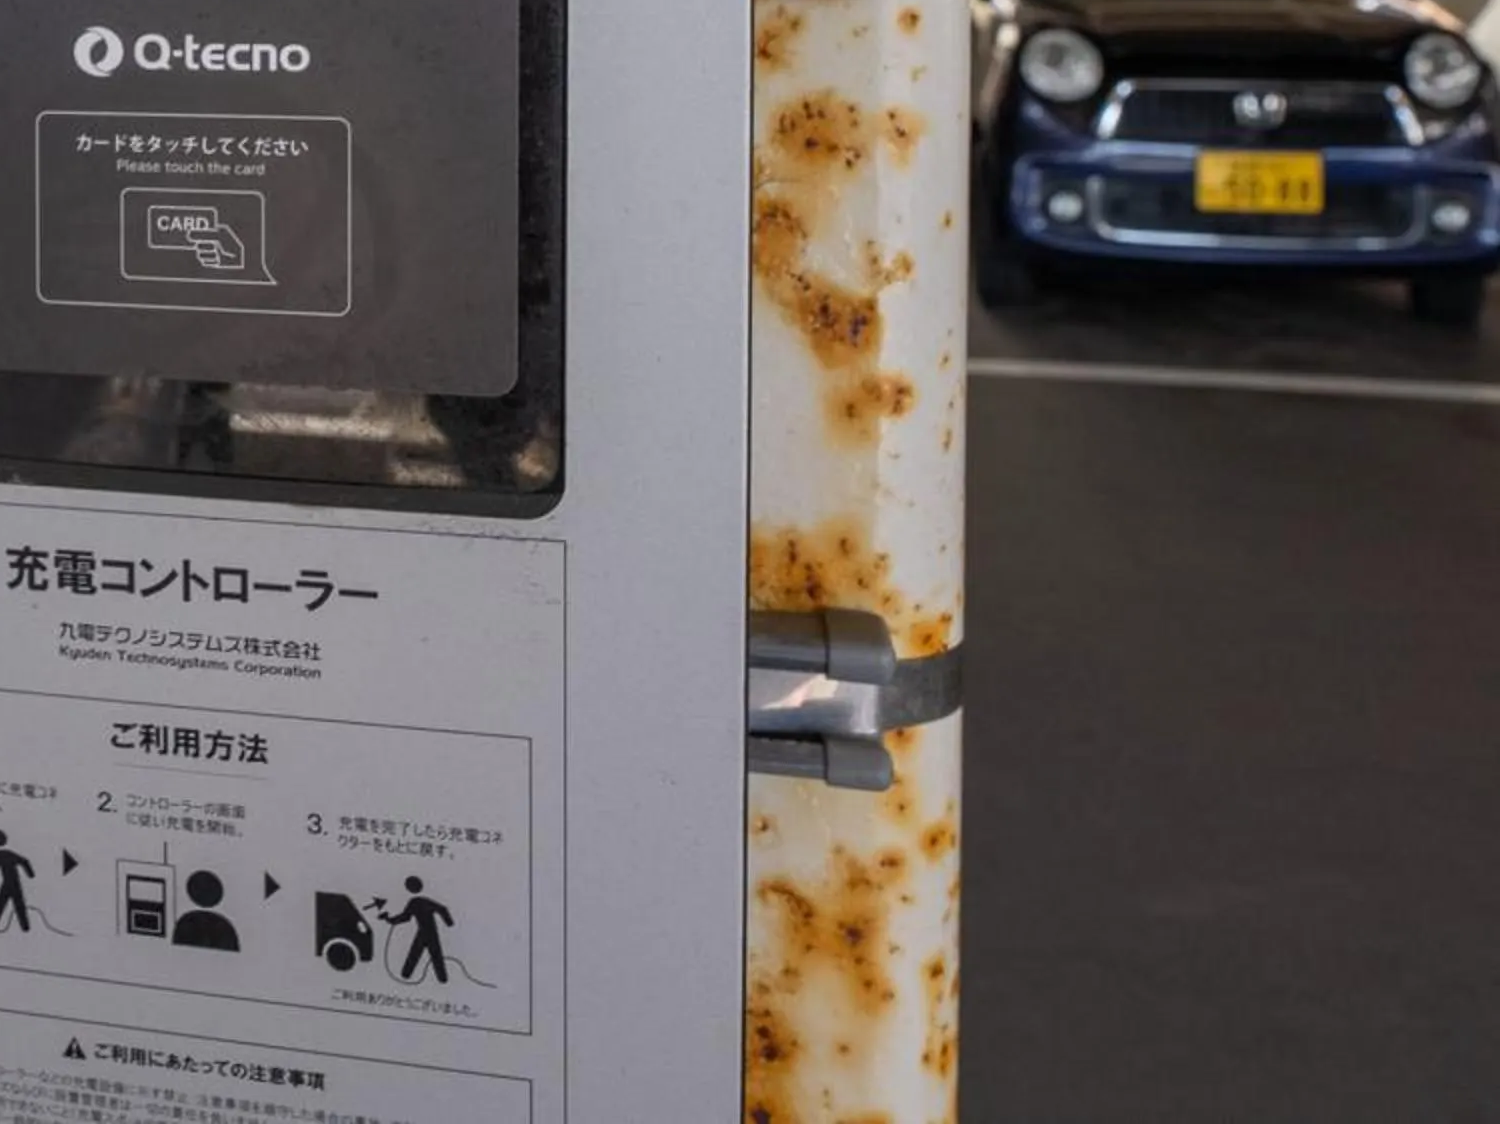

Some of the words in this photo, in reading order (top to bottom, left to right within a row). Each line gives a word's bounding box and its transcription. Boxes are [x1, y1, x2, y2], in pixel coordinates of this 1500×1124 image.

[133, 32, 311, 73] Q-tecno
[76, 134, 309, 157] カードをタッチしてください
[116, 159, 161, 174] Please
[164, 160, 204, 174] touch
[207, 161, 232, 175] the
[234, 161, 266, 176] card
[156, 215, 210, 232] CARD
[6, 546, 380, 611] 充電コントローラー
[59, 621, 322, 661] 九電テクノシステムズ株式会社
[58, 644, 112, 661] Kyuden
[117, 649, 230, 671] Technosystems
[233, 659, 322, 679] Corporation
[109, 721, 269, 765] ご利用方法
[93, 1042, 325, 1091] ご利用にあたっての注意事項
